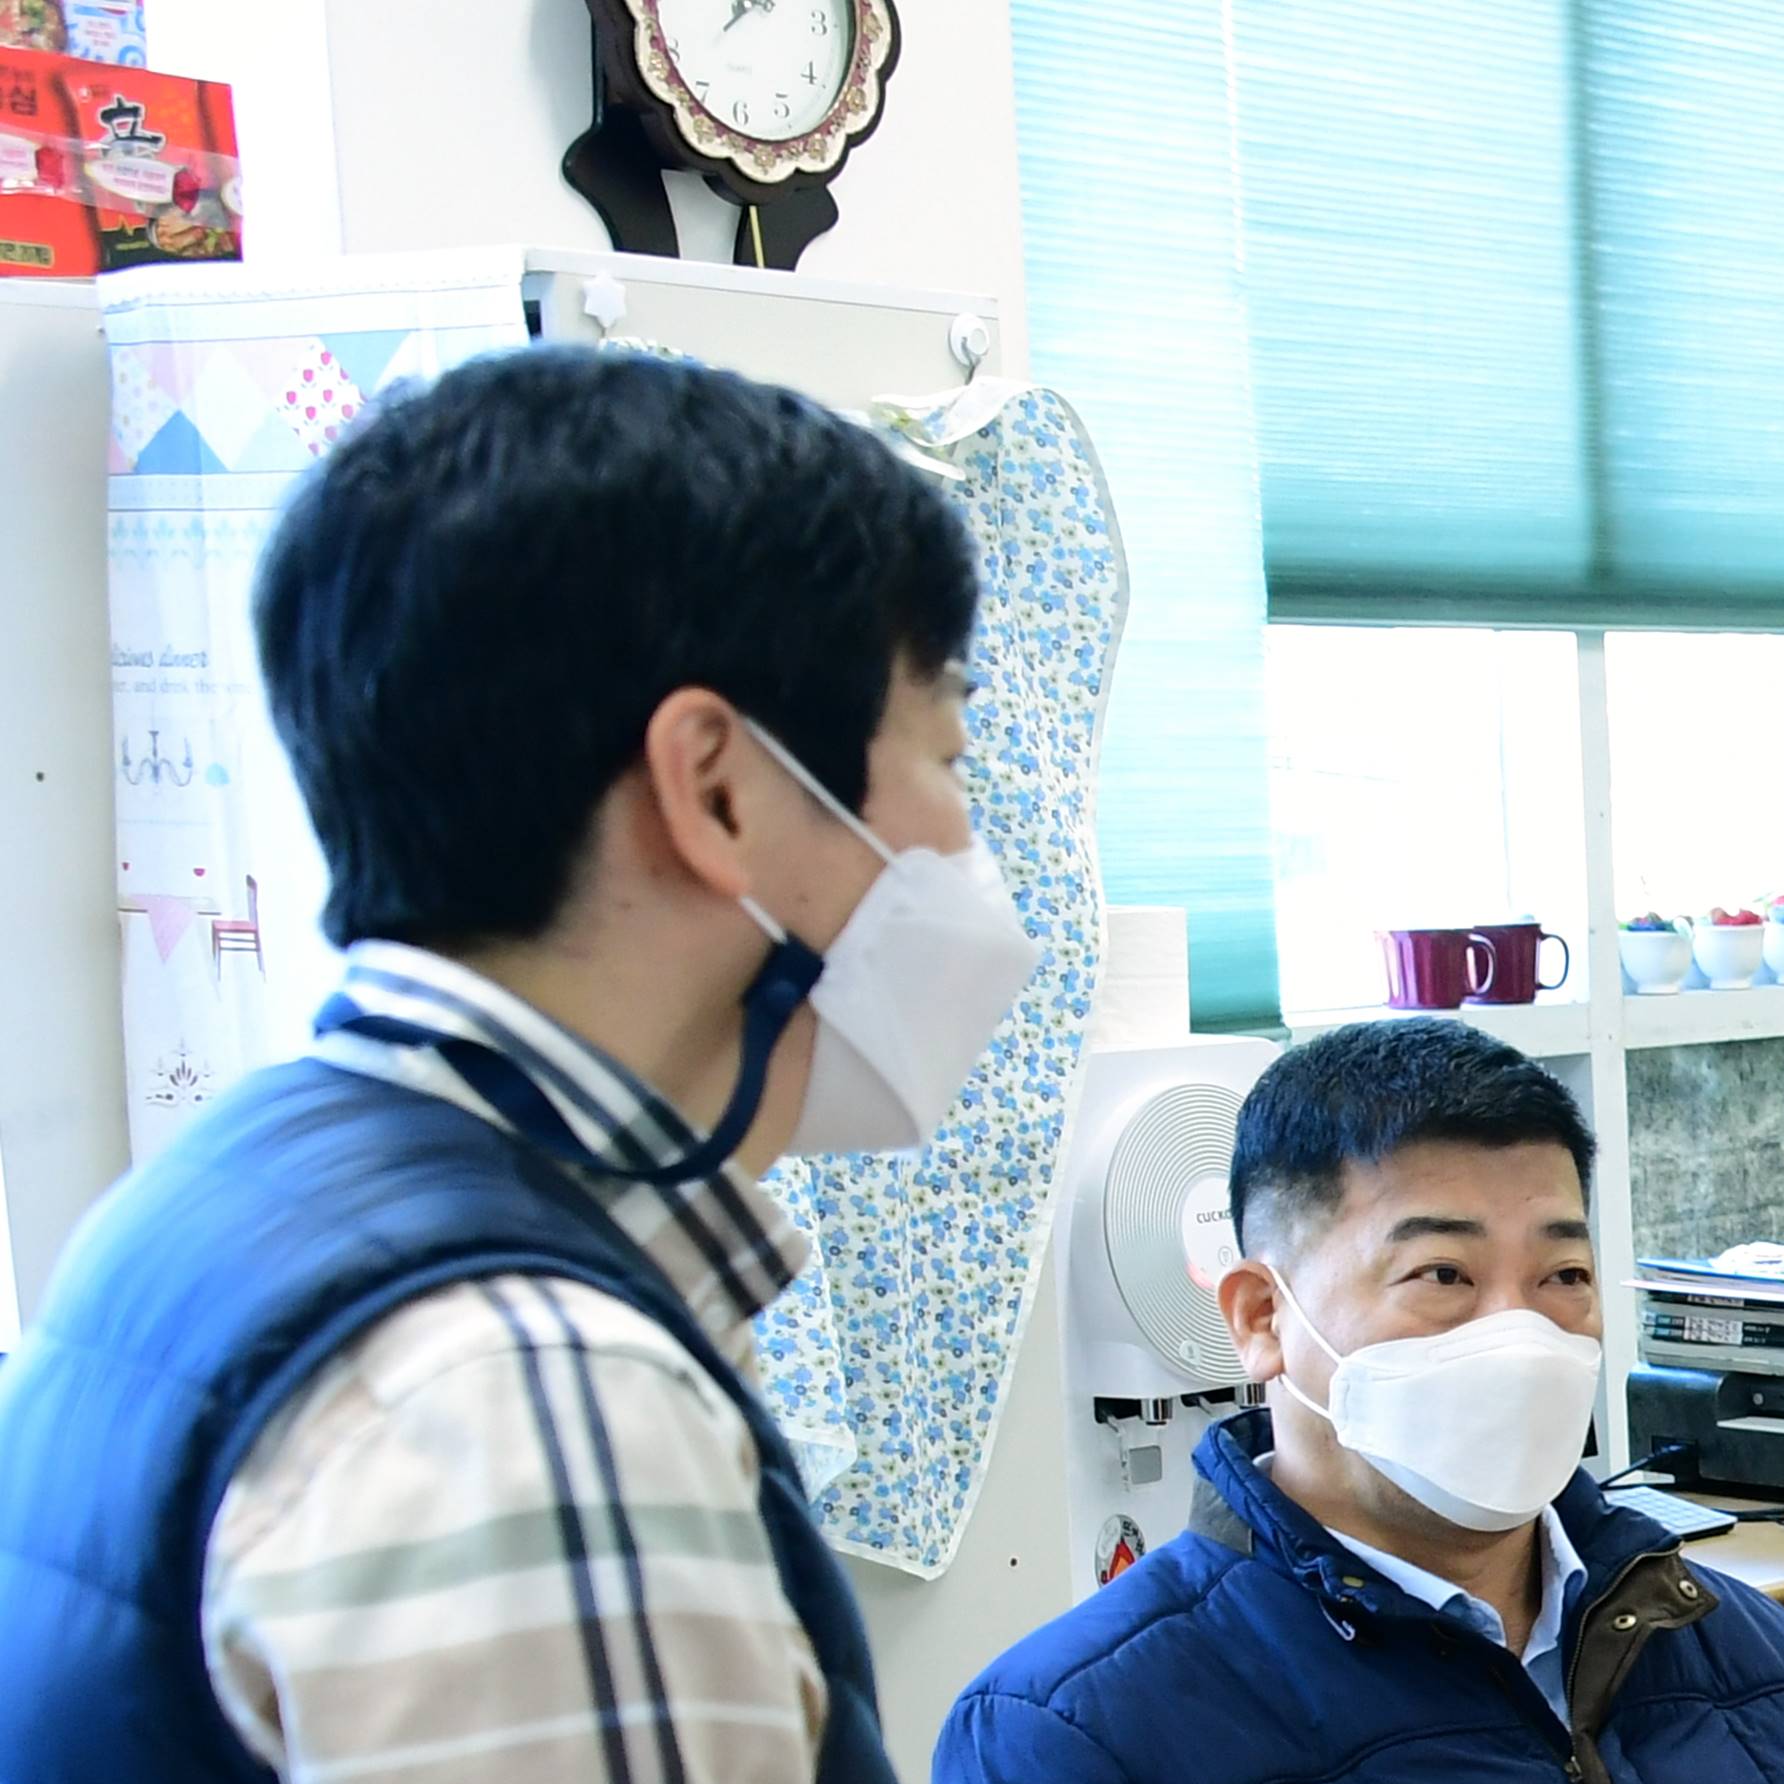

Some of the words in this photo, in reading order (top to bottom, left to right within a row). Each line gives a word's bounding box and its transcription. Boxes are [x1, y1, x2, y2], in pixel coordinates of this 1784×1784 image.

[811, 11, 827, 36] 3
[801, 61, 818, 85] 4
[695, 80, 710, 104] 7
[732, 101, 749, 126] 6
[774, 93, 790, 119] 5
[1196, 1210, 1232, 1224] CUCKO
